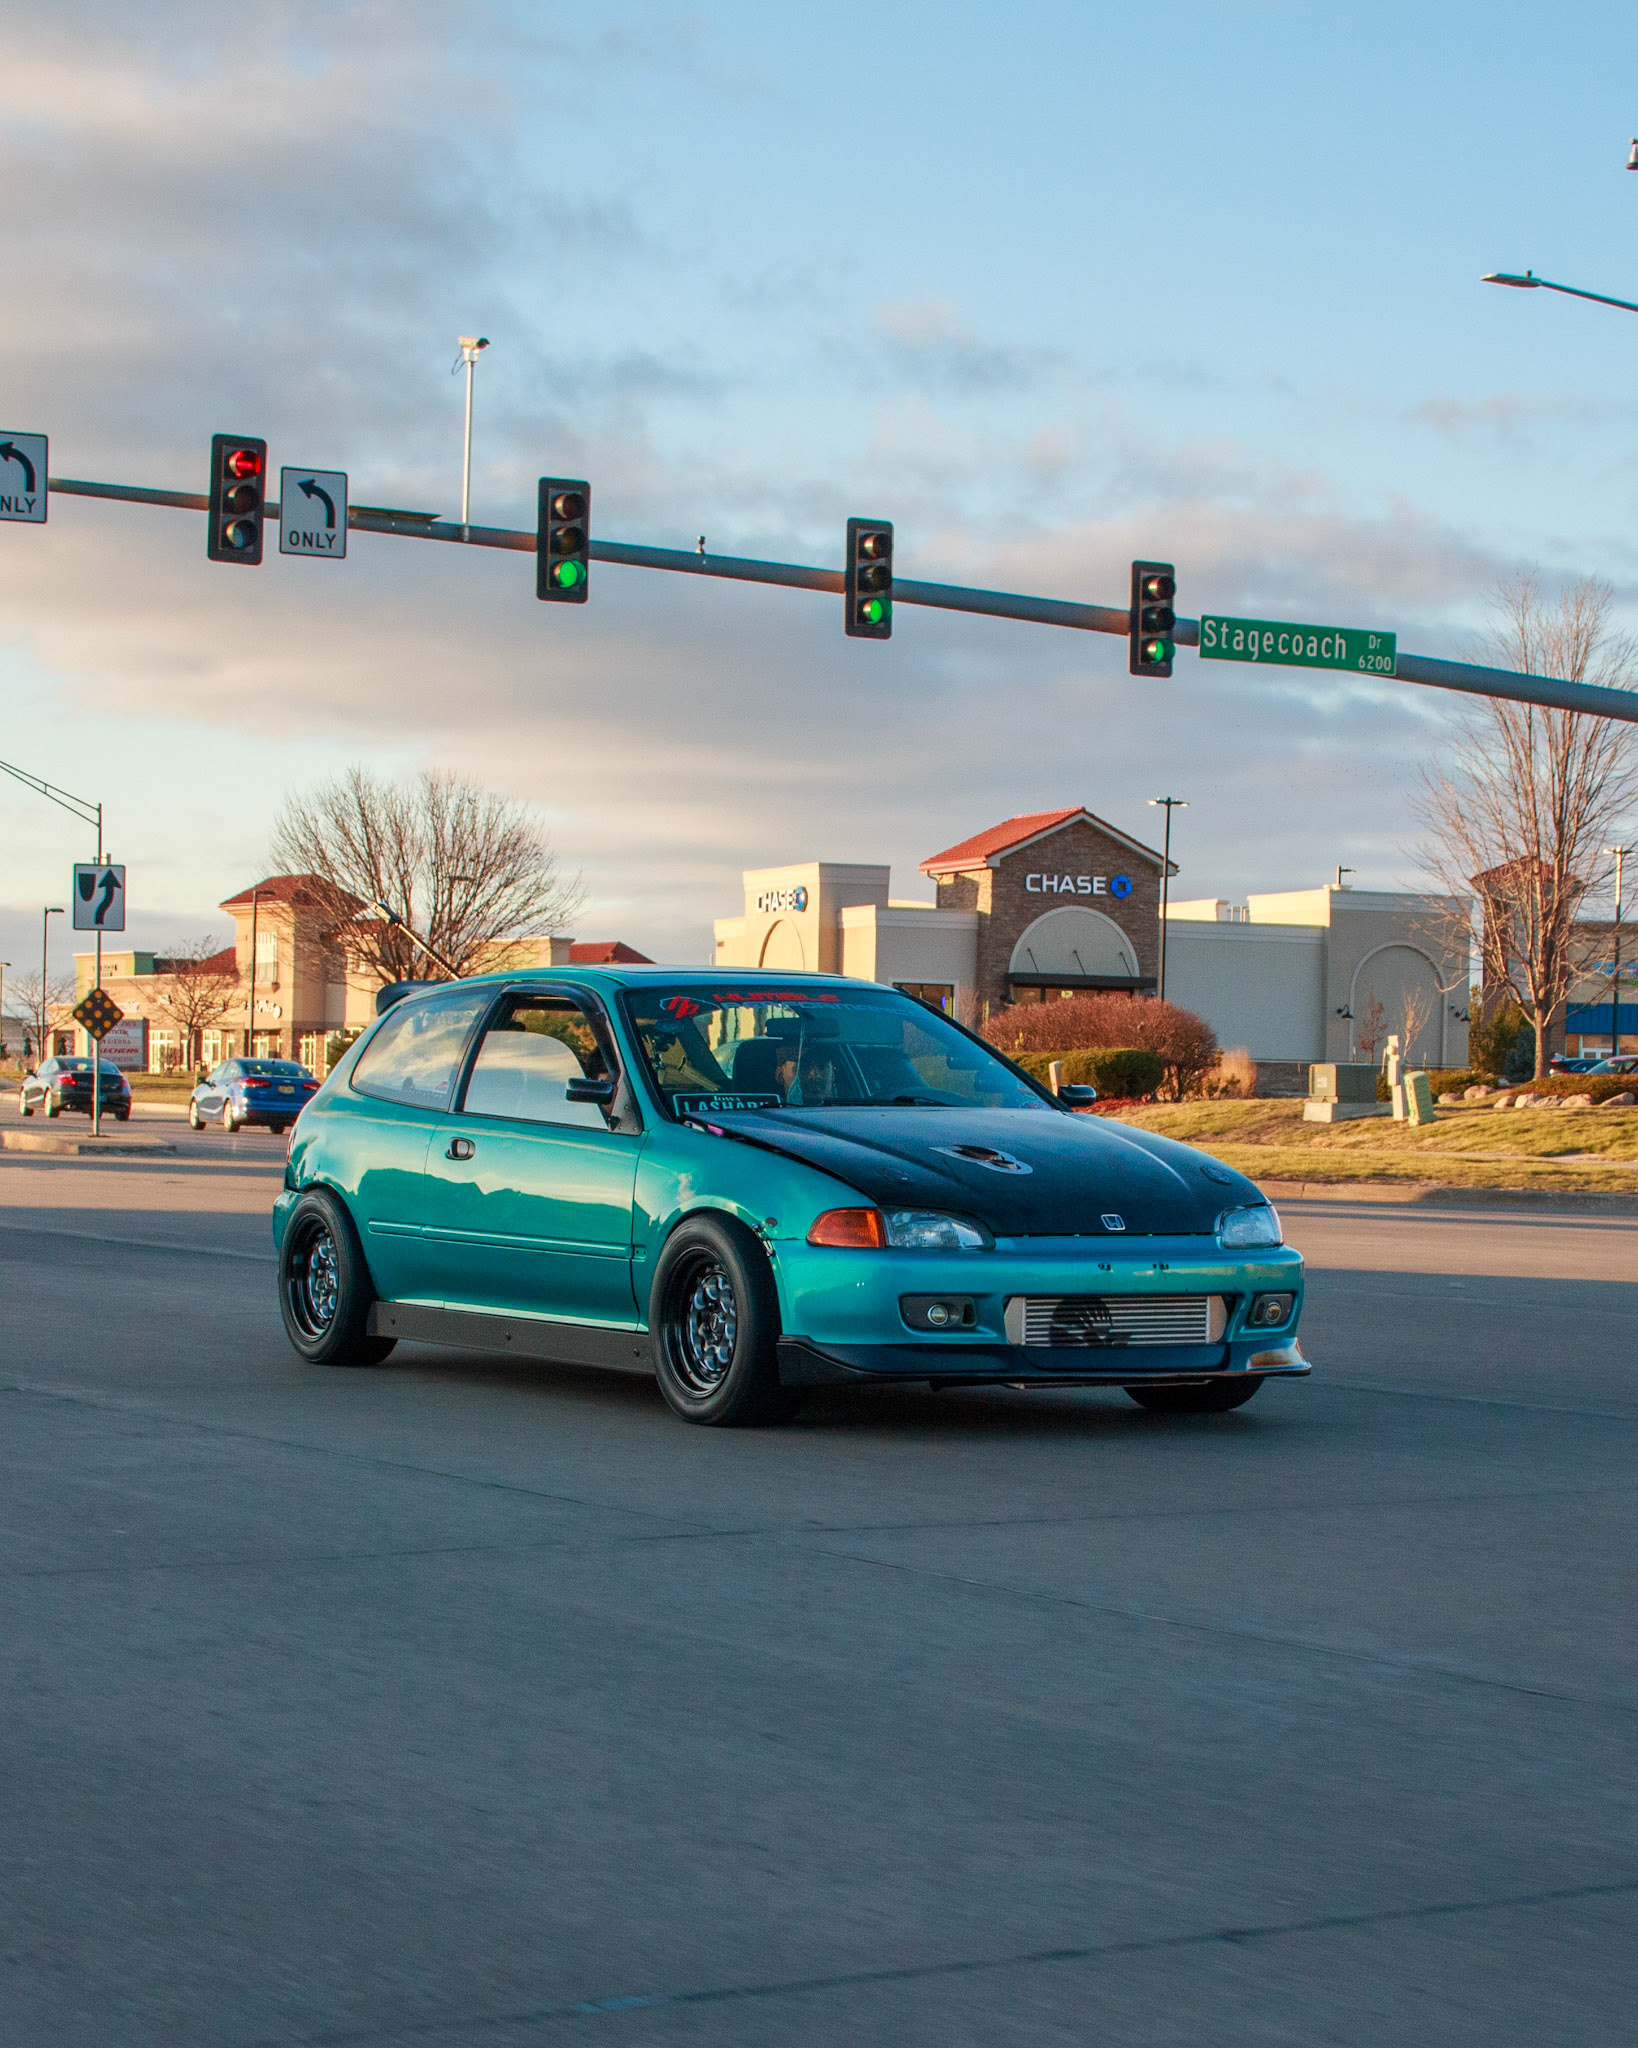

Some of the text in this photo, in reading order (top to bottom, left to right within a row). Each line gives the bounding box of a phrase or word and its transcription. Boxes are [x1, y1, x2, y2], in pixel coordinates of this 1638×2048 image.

[0, 496, 36, 513] NLY
[289, 531, 336, 549] ONLY
[1203, 619, 1382, 661] Stagecoach Dr
[1358, 655, 1392, 671] 6200
[1025, 874, 1107, 895] CHASE
[756, 889, 795, 913] CHASE
